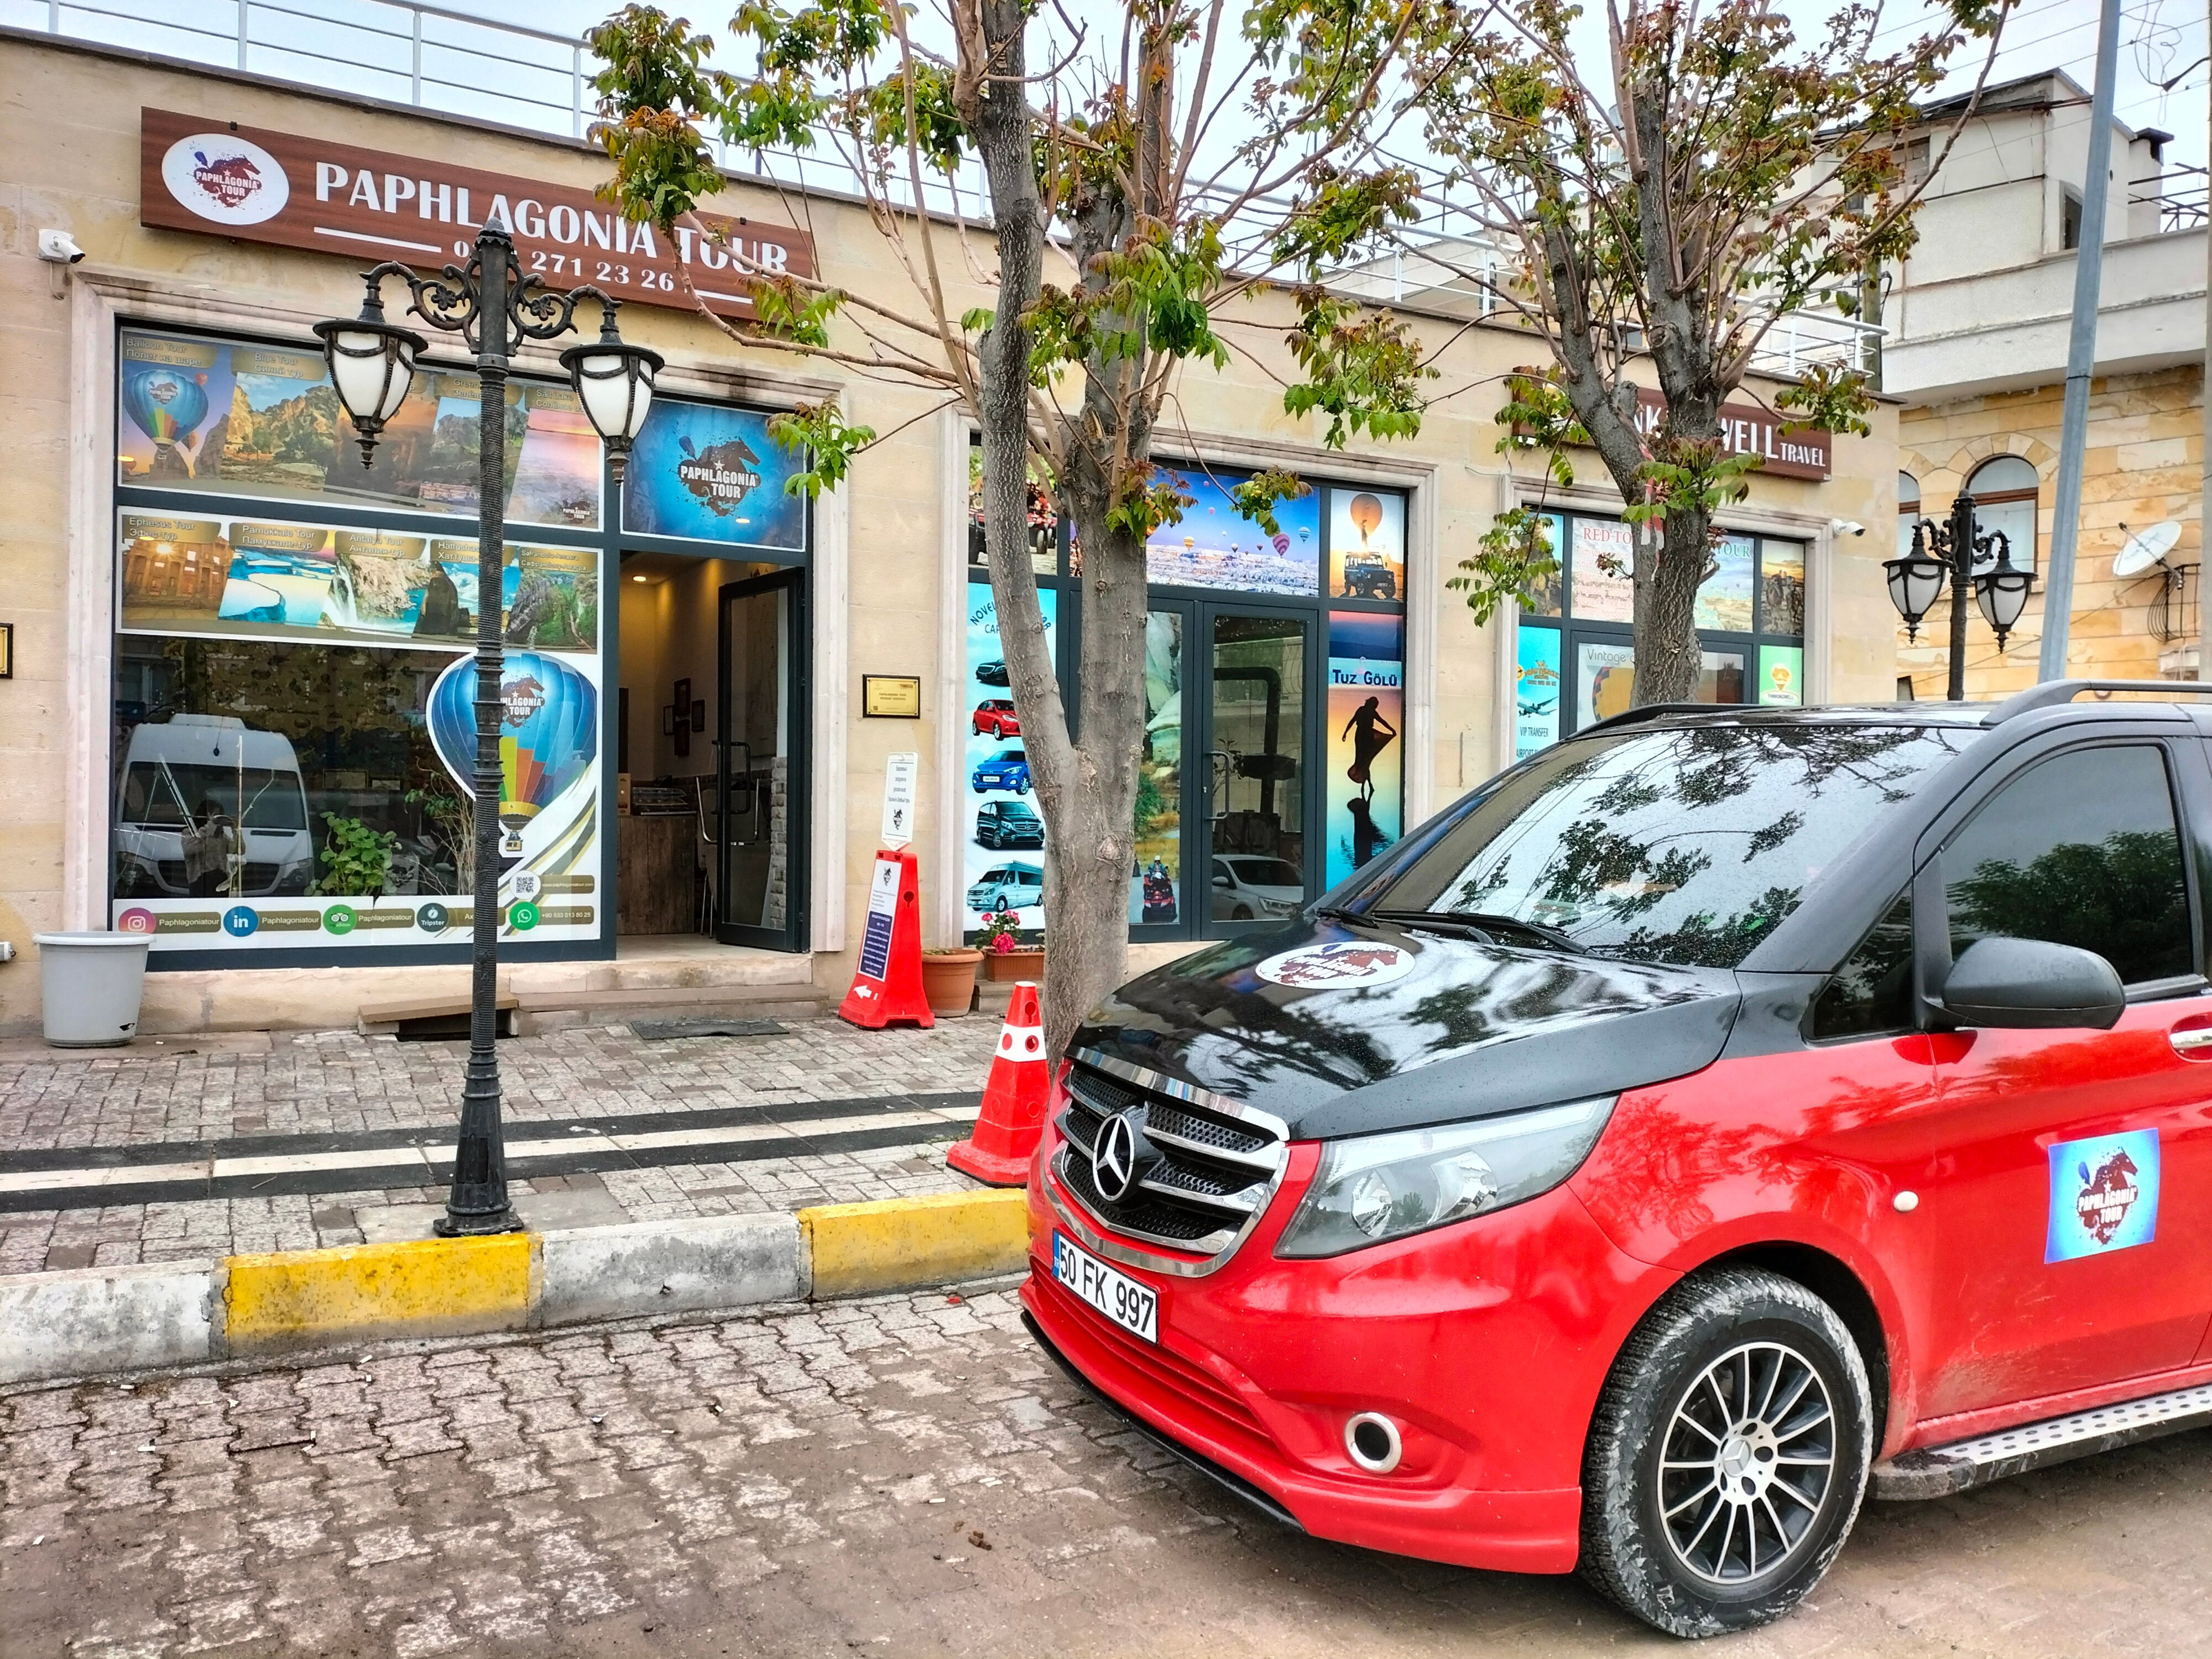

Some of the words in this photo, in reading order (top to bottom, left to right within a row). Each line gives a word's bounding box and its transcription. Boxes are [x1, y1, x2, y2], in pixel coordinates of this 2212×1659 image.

[196, 171, 258, 189] PAPHLAGONIA
[221, 185, 246, 196] TOUR
[316, 161, 658, 258] PAPHLAGONIA
[674, 226, 787, 278] TOUR
[531, 251, 582, 276] 271
[596, 262, 630, 285] 23
[641, 269, 675, 292] 26
[127, 338, 163, 350] Balloon
[166, 343, 187, 353] Tour
[126, 349, 157, 360] Полет
[175, 357, 201, 366] шаре
[255, 353, 275, 363] Blue
[278, 356, 298, 366] Tour
[255, 364, 285, 374] Синий
[536, 389, 552, 399] Salt
[555, 392, 574, 401] Lake
[1780, 442, 1826, 467] TRAVEL
[681, 466, 756, 487] PAPHLAGONIA
[711, 483, 741, 498] TOUR
[129, 518, 171, 528] Ephesus
[175, 521, 195, 530] Tour
[242, 525, 293, 536] Pamukkale
[296, 530, 315, 539] Tour
[1583, 527, 1610, 542] RED
[1614, 530, 1632, 545] TO
[349, 534, 382, 545] Antalya
[385, 537, 403, 545] Tour
[500, 697, 541, 707] HLAGONIA
[509, 706, 530, 716] TOUR
[1528, 727, 1549, 737] TRANSFER
[159, 917, 219, 928] Paphlagoniatour
[262, 916, 319, 926] Paphlagoniatour
[358, 914, 412, 923] Paphlagoniatour
[2078, 1188, 2135, 1212] PAPHLAGONIA
[2100, 1206, 2123, 1224] TOUR
[1060, 1240, 1077, 1286] 50
[1083, 1257, 1108, 1311] FK
[1115, 1280, 1154, 1333] 997
